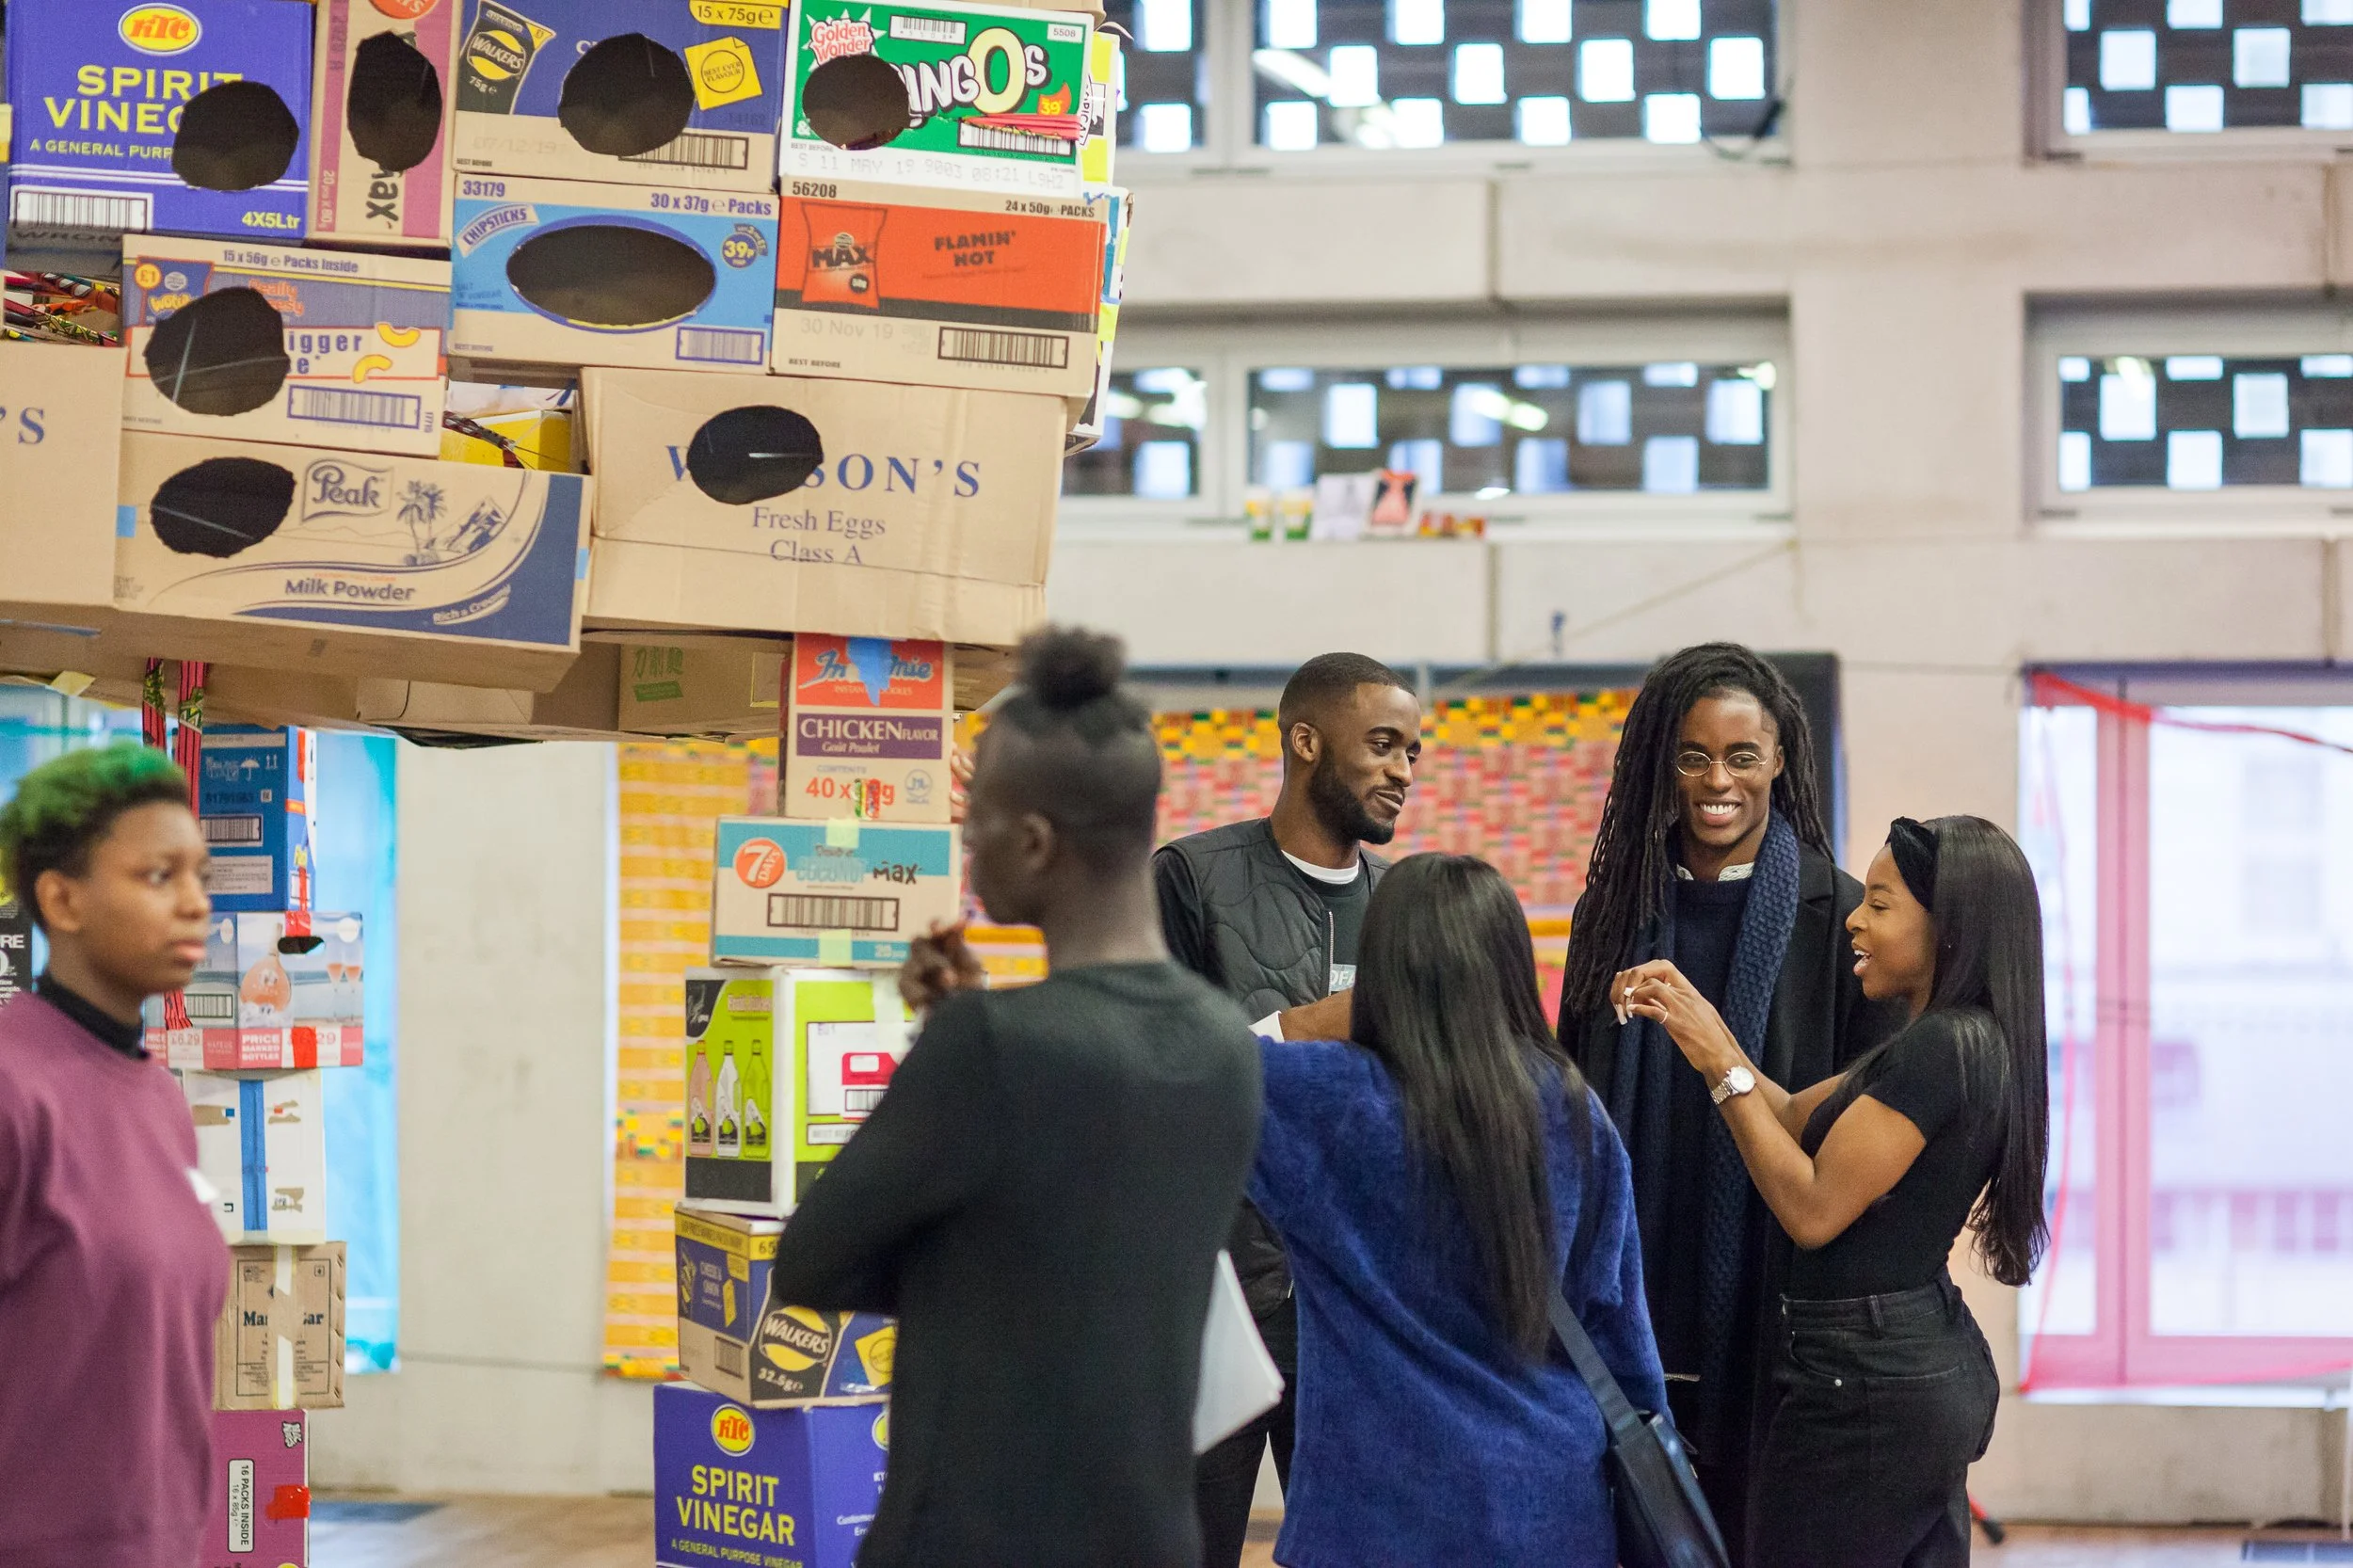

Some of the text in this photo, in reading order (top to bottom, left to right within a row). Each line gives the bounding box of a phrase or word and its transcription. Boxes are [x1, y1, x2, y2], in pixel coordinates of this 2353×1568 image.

[697, 5, 712, 18] 15
[728, 8, 757, 24] 75g
[813, 23, 867, 46] Golden
[1052, 29, 1076, 38] 5508
[472, 36, 524, 69] WALKERS
[813, 38, 872, 62] Wonder
[77, 64, 243, 100] SPIRI
[30, 139, 171, 159] A GENERAL PURP
[808, 144, 834, 152] BEFORE
[849, 157, 883, 174] MAY
[463, 180, 505, 197] 33179
[651, 193, 669, 208] 30
[673, 198, 680, 208] x
[684, 196, 709, 214] 37g
[728, 199, 772, 216] Packs
[792, 181, 837, 199] 56208
[1005, 200, 1018, 212] 24
[1029, 201, 1049, 215] 50g
[1061, 204, 1096, 217] PACKS
[463, 207, 528, 247] CHIPSTICKS
[224, 249, 234, 262] 15
[247, 252, 268, 266] 56g
[284, 254, 320, 271] Packs
[322, 257, 358, 273] Inside
[812, 245, 874, 268] MAX
[954, 251, 995, 266] HOT
[801, 317, 823, 334] 30
[829, 320, 864, 338] Nov
[288, 331, 362, 355] igger
[789, 358, 840, 368] BEST BEFORE
[312, 464, 380, 508] Peak
[752, 505, 887, 538] Fresh Eggs
[771, 539, 864, 565] Class A
[284, 577, 416, 601] Milk Powder
[801, 718, 939, 742] CHICKEN FLAVOR
[806, 777, 835, 798] 40
[744, 845, 773, 883] 7
[759, 850, 780, 882] DAYS
[242, 1034, 280, 1045] PRICE
[242, 1045, 280, 1053] MARKED
[242, 1053, 280, 1062] BOTTLES
[759, 1240, 776, 1255] 65
[764, 1318, 830, 1355] WALKERS
[718, 1416, 749, 1440] KTC
[692, 1464, 779, 1507] SPIRIT
[241, 1465, 249, 1545] 16 PACKS INSIDE
[677, 1496, 795, 1546] VINEGAR
[679, 1540, 719, 1559] GENERAL
[721, 1547, 760, 1565] PURPOSE
